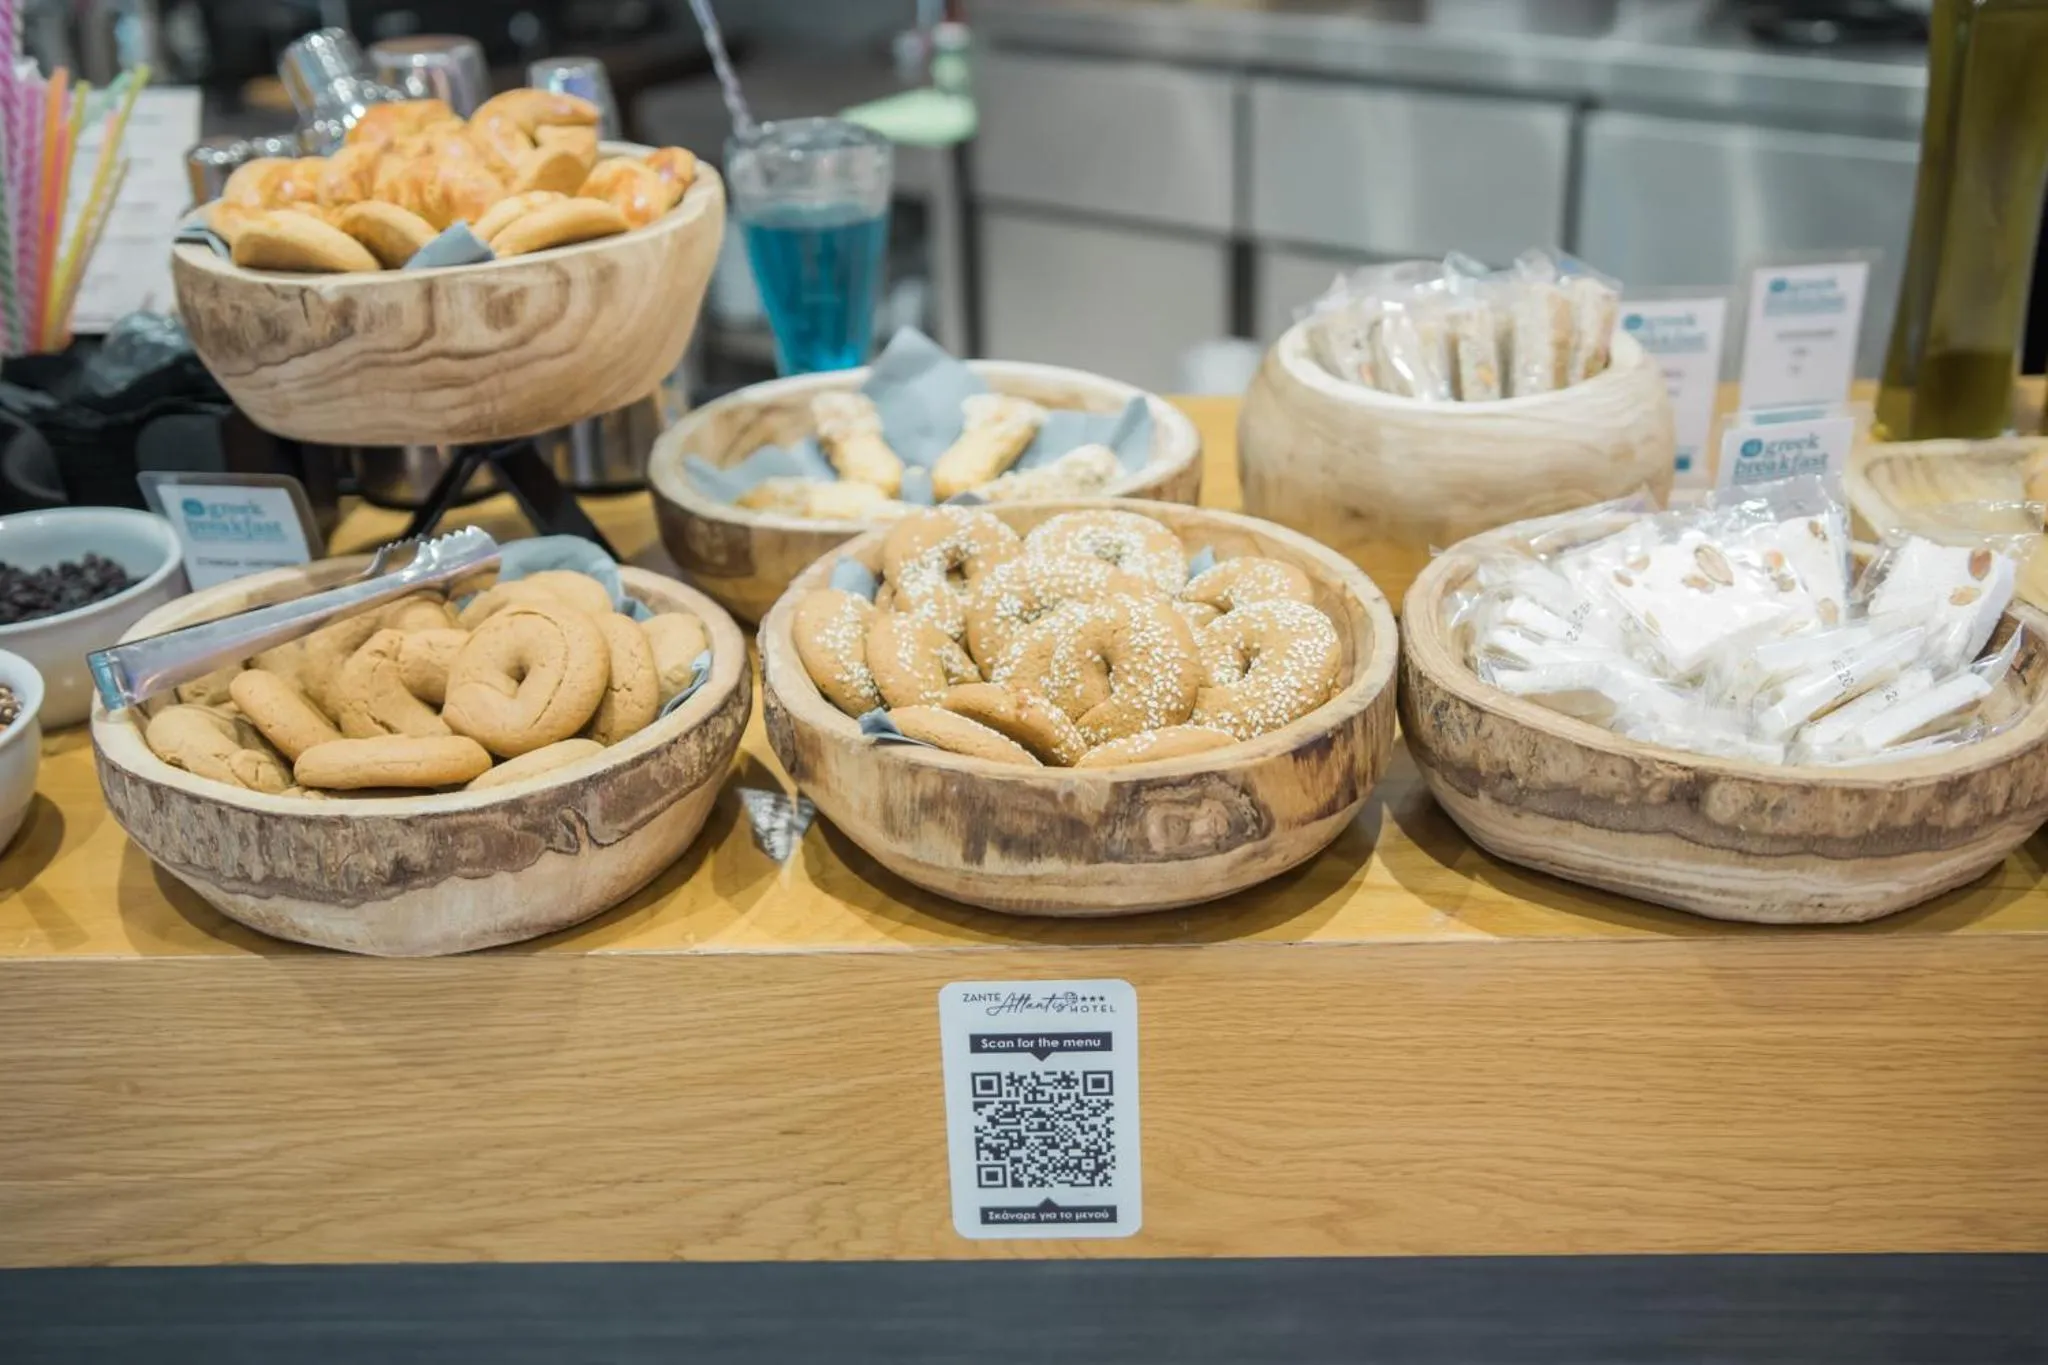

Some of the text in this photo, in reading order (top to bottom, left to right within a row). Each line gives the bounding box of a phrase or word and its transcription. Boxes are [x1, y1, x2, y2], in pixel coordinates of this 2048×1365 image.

[962, 992, 1116, 1016] ZANTE Atlantis HOTEL
[981, 1036, 1101, 1049] Scan for the menu
[988, 1209, 1110, 1222] Σκάναρε για το μενού
